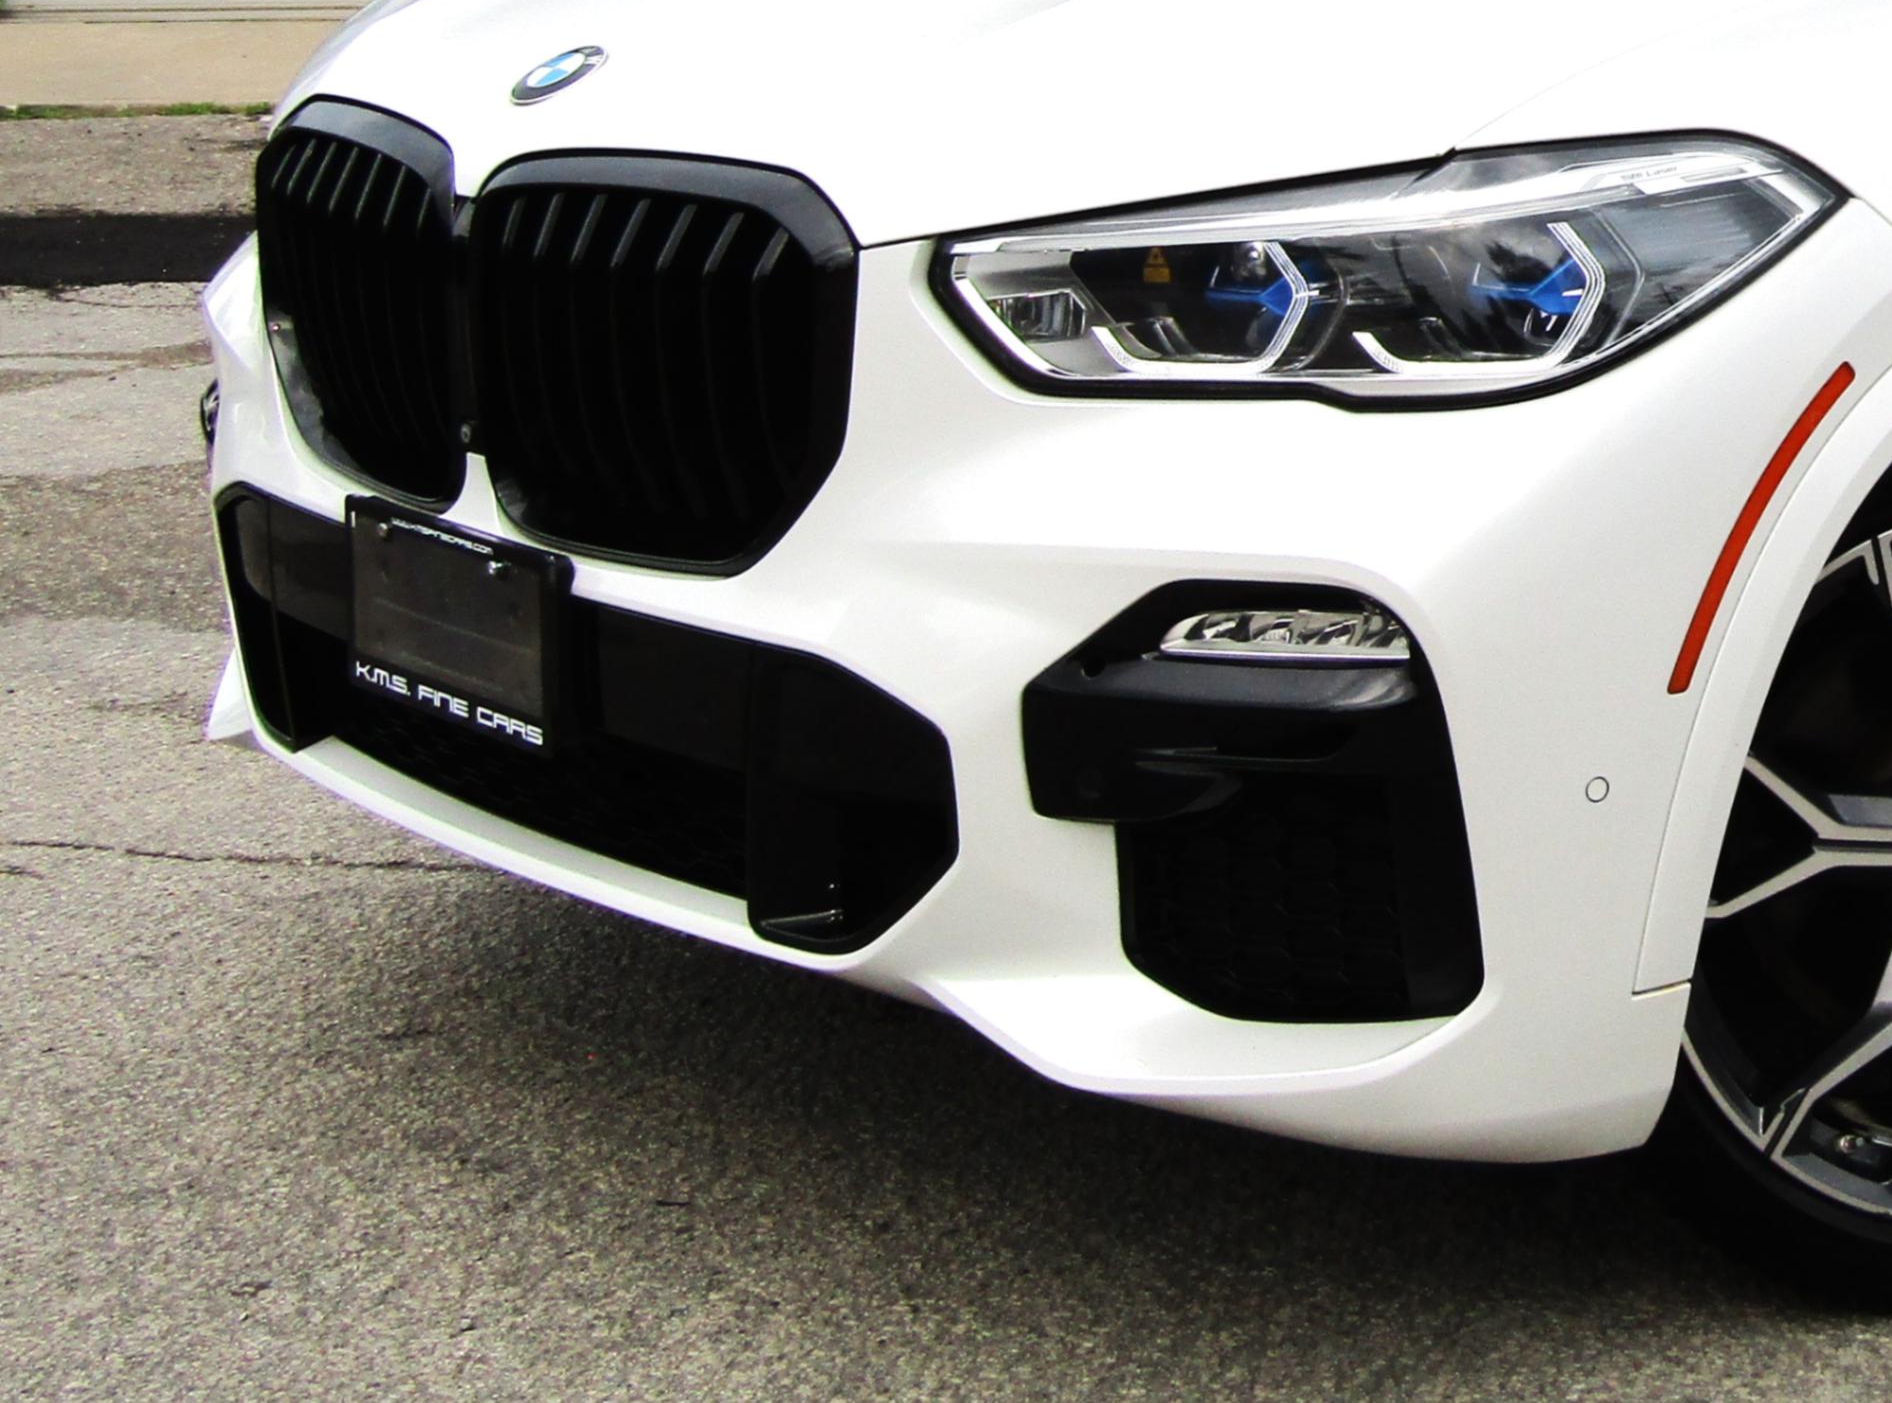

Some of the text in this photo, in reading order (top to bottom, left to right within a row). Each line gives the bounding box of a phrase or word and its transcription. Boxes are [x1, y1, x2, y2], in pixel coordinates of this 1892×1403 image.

[355, 660, 544, 746] K.M.S. FINE CARS
